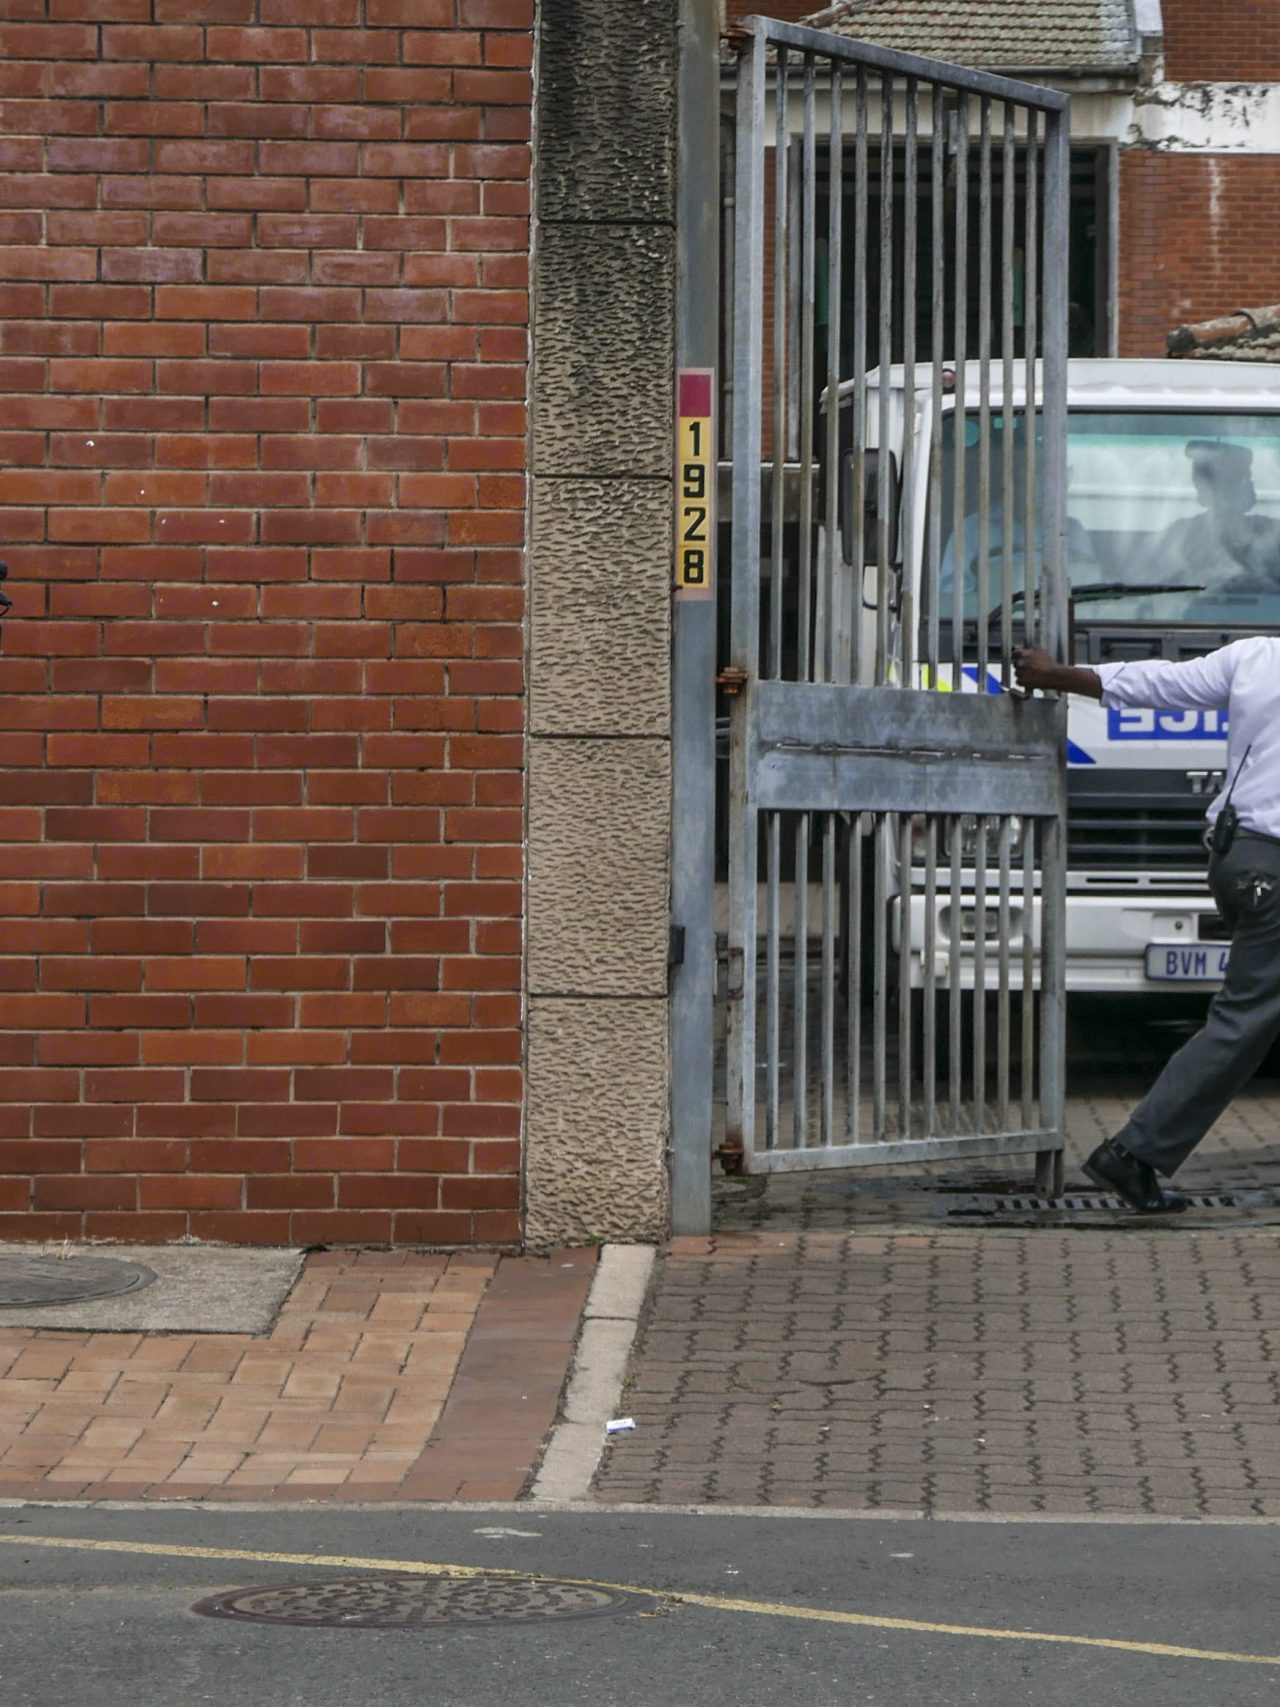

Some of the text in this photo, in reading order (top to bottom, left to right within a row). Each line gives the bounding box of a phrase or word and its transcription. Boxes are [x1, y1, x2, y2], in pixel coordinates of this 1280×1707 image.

[682, 421, 707, 584] 1928
[1185, 771, 1224, 794] TA
[1165, 950, 1229, 976] BVM 4
